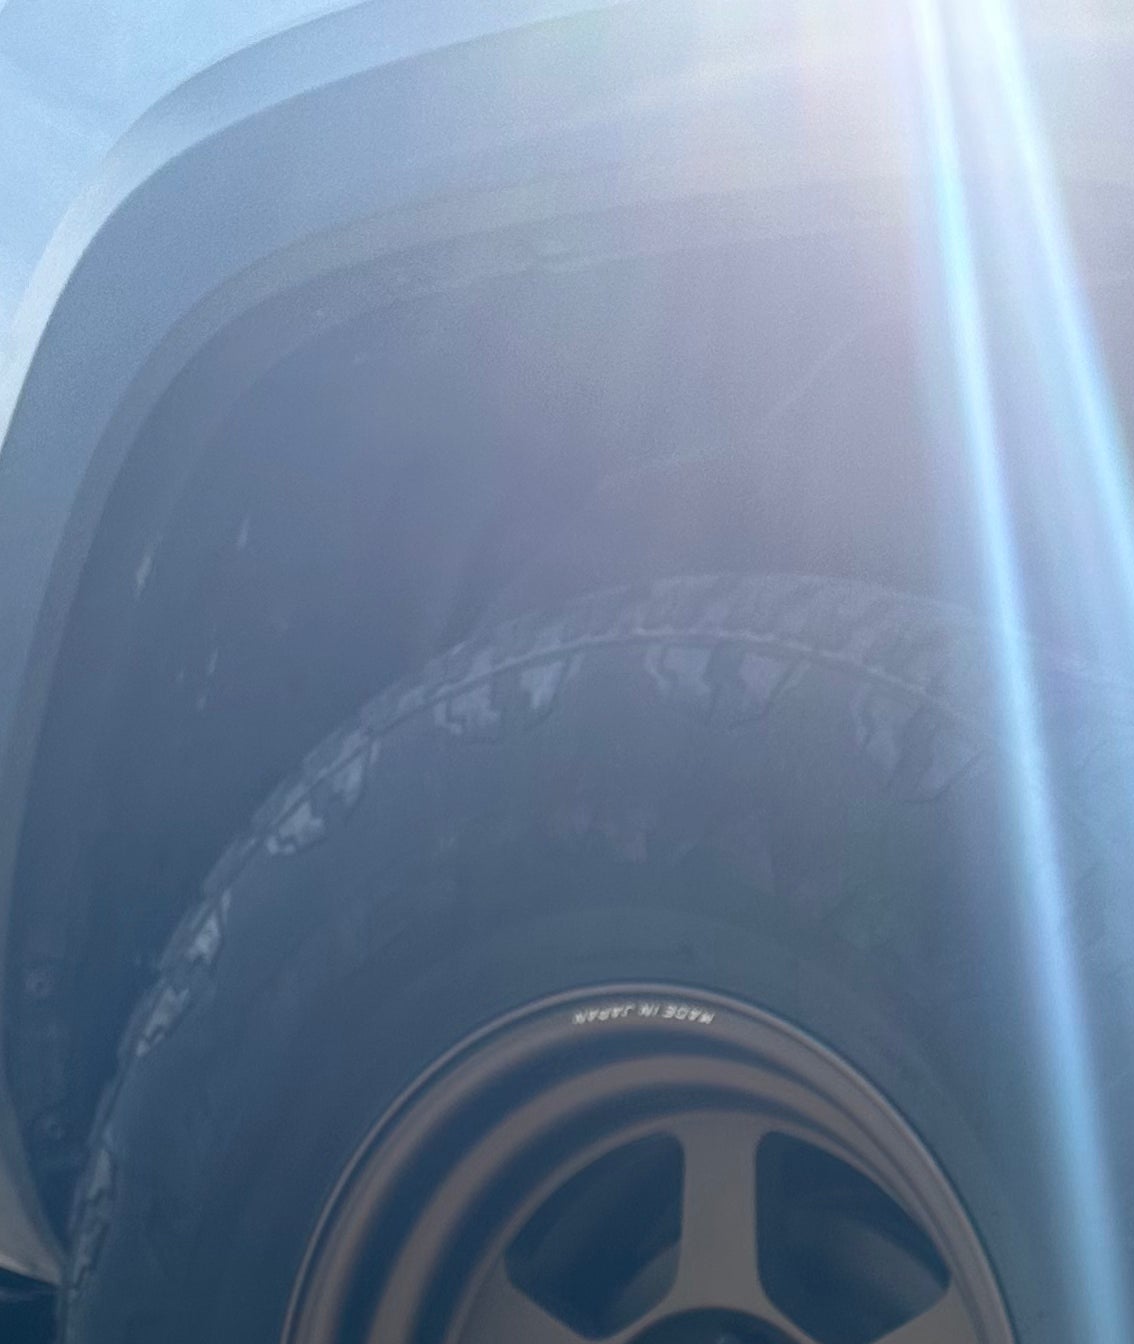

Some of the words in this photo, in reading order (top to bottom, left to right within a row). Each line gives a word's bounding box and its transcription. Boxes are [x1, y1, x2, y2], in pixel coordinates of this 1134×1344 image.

[573, 1004, 635, 1025] JAPAN
[639, 1002, 660, 1017] IN
[662, 1004, 716, 1024] MADE
